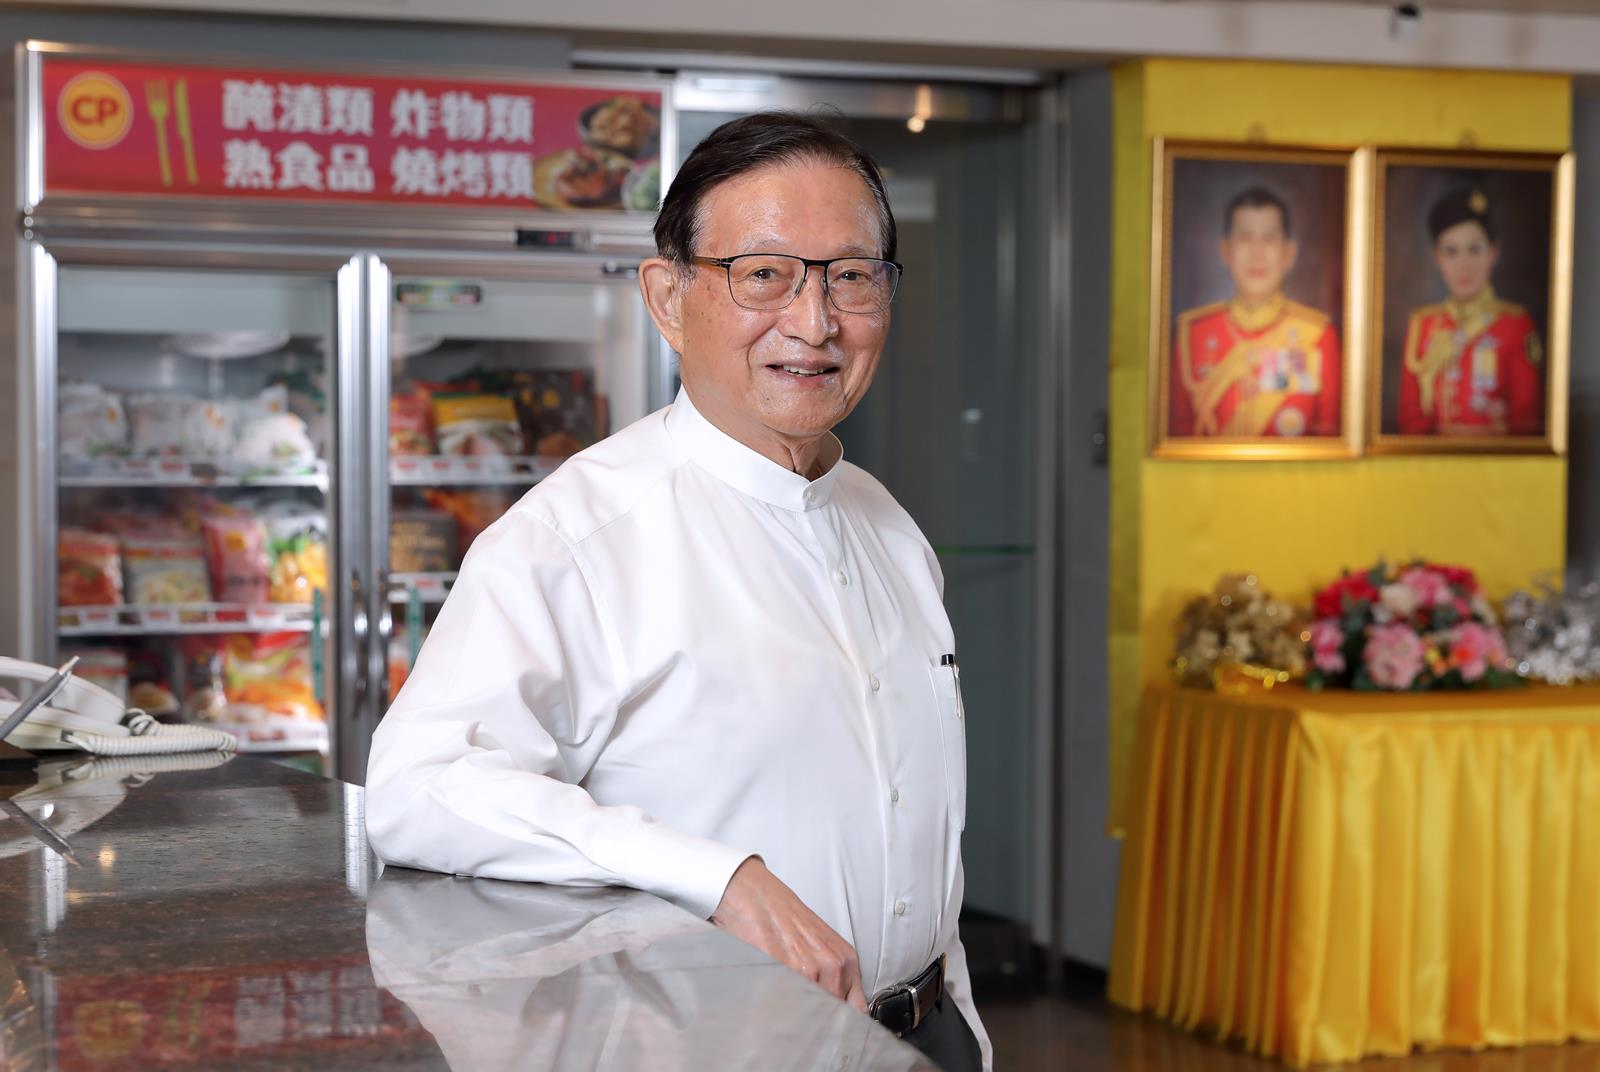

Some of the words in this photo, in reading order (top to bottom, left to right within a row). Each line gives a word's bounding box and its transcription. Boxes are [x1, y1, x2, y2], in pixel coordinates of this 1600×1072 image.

[73, 95, 119, 126] CP
[223, 79, 373, 135] 醃漬類
[391, 89, 534, 143] 炸物類
[223, 139, 374, 192] 熟食品
[391, 146, 535, 198] 燒烤類
